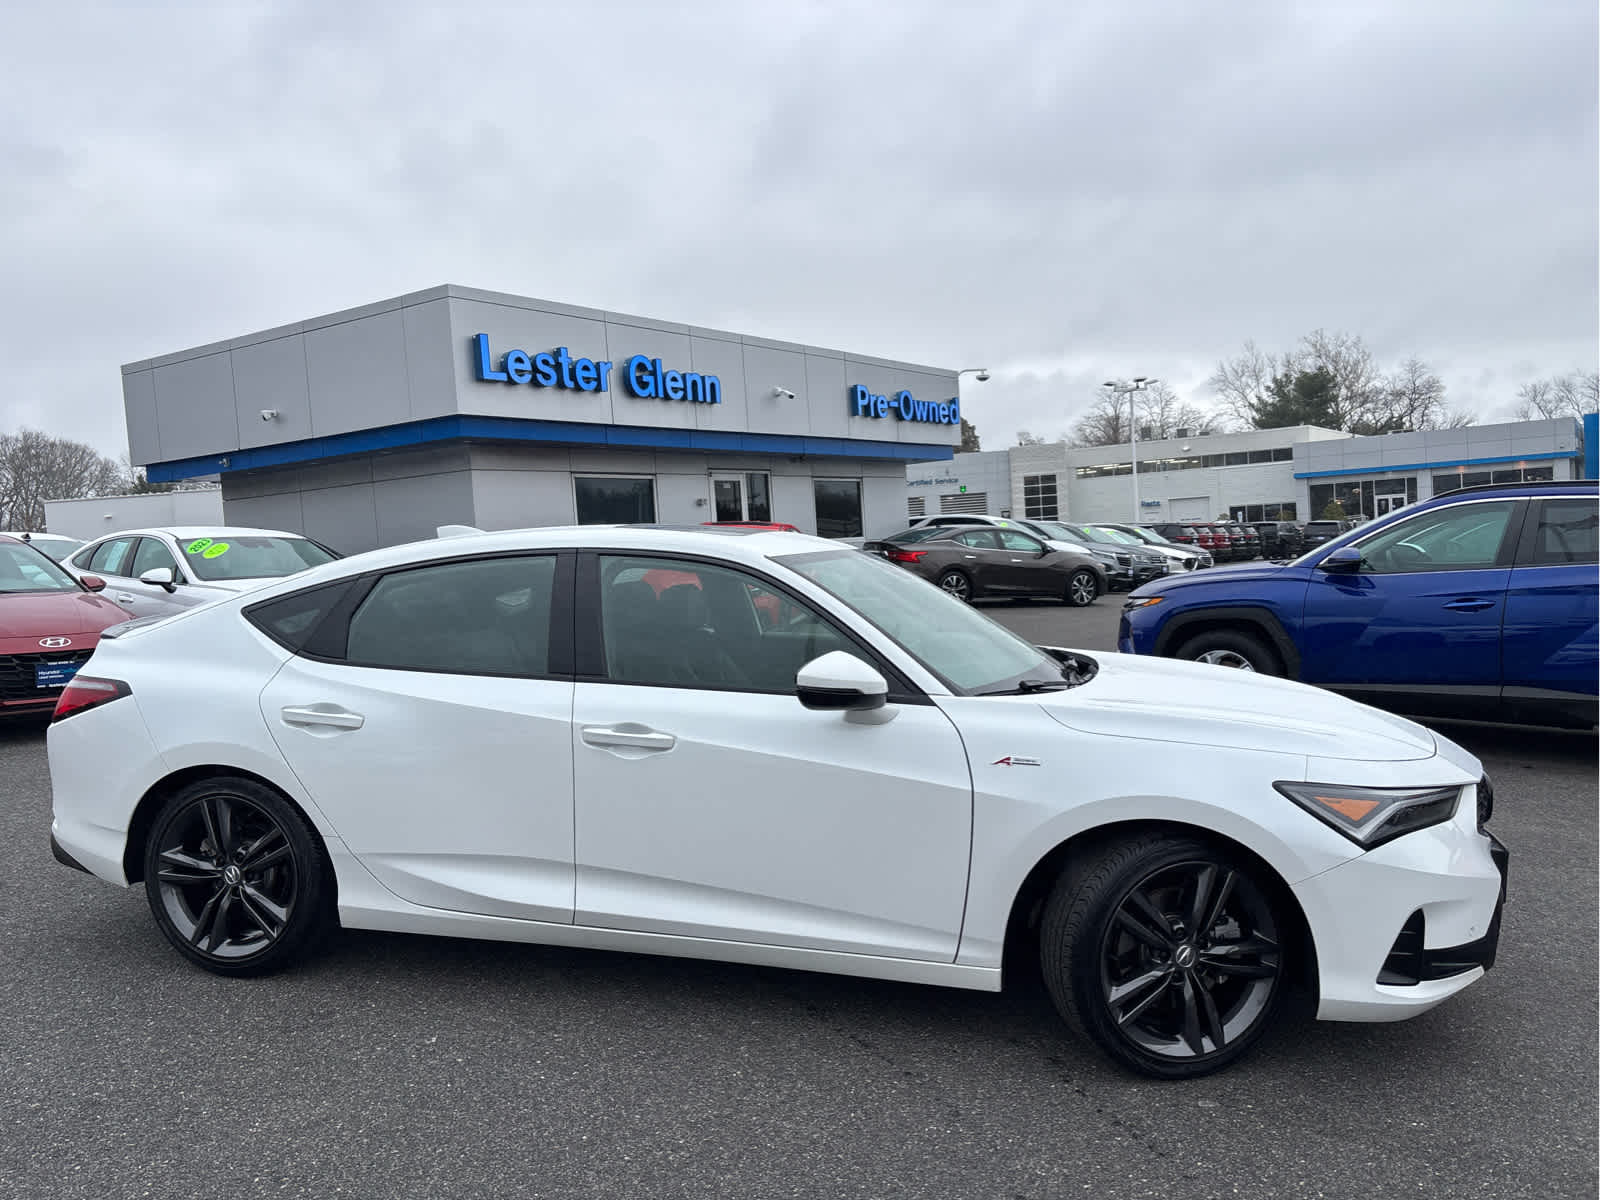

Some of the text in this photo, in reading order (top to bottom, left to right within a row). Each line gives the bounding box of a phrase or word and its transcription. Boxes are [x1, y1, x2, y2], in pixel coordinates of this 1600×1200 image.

[472, 333, 722, 404] Lester Glenn
[850, 384, 960, 425] Pre-Owned
